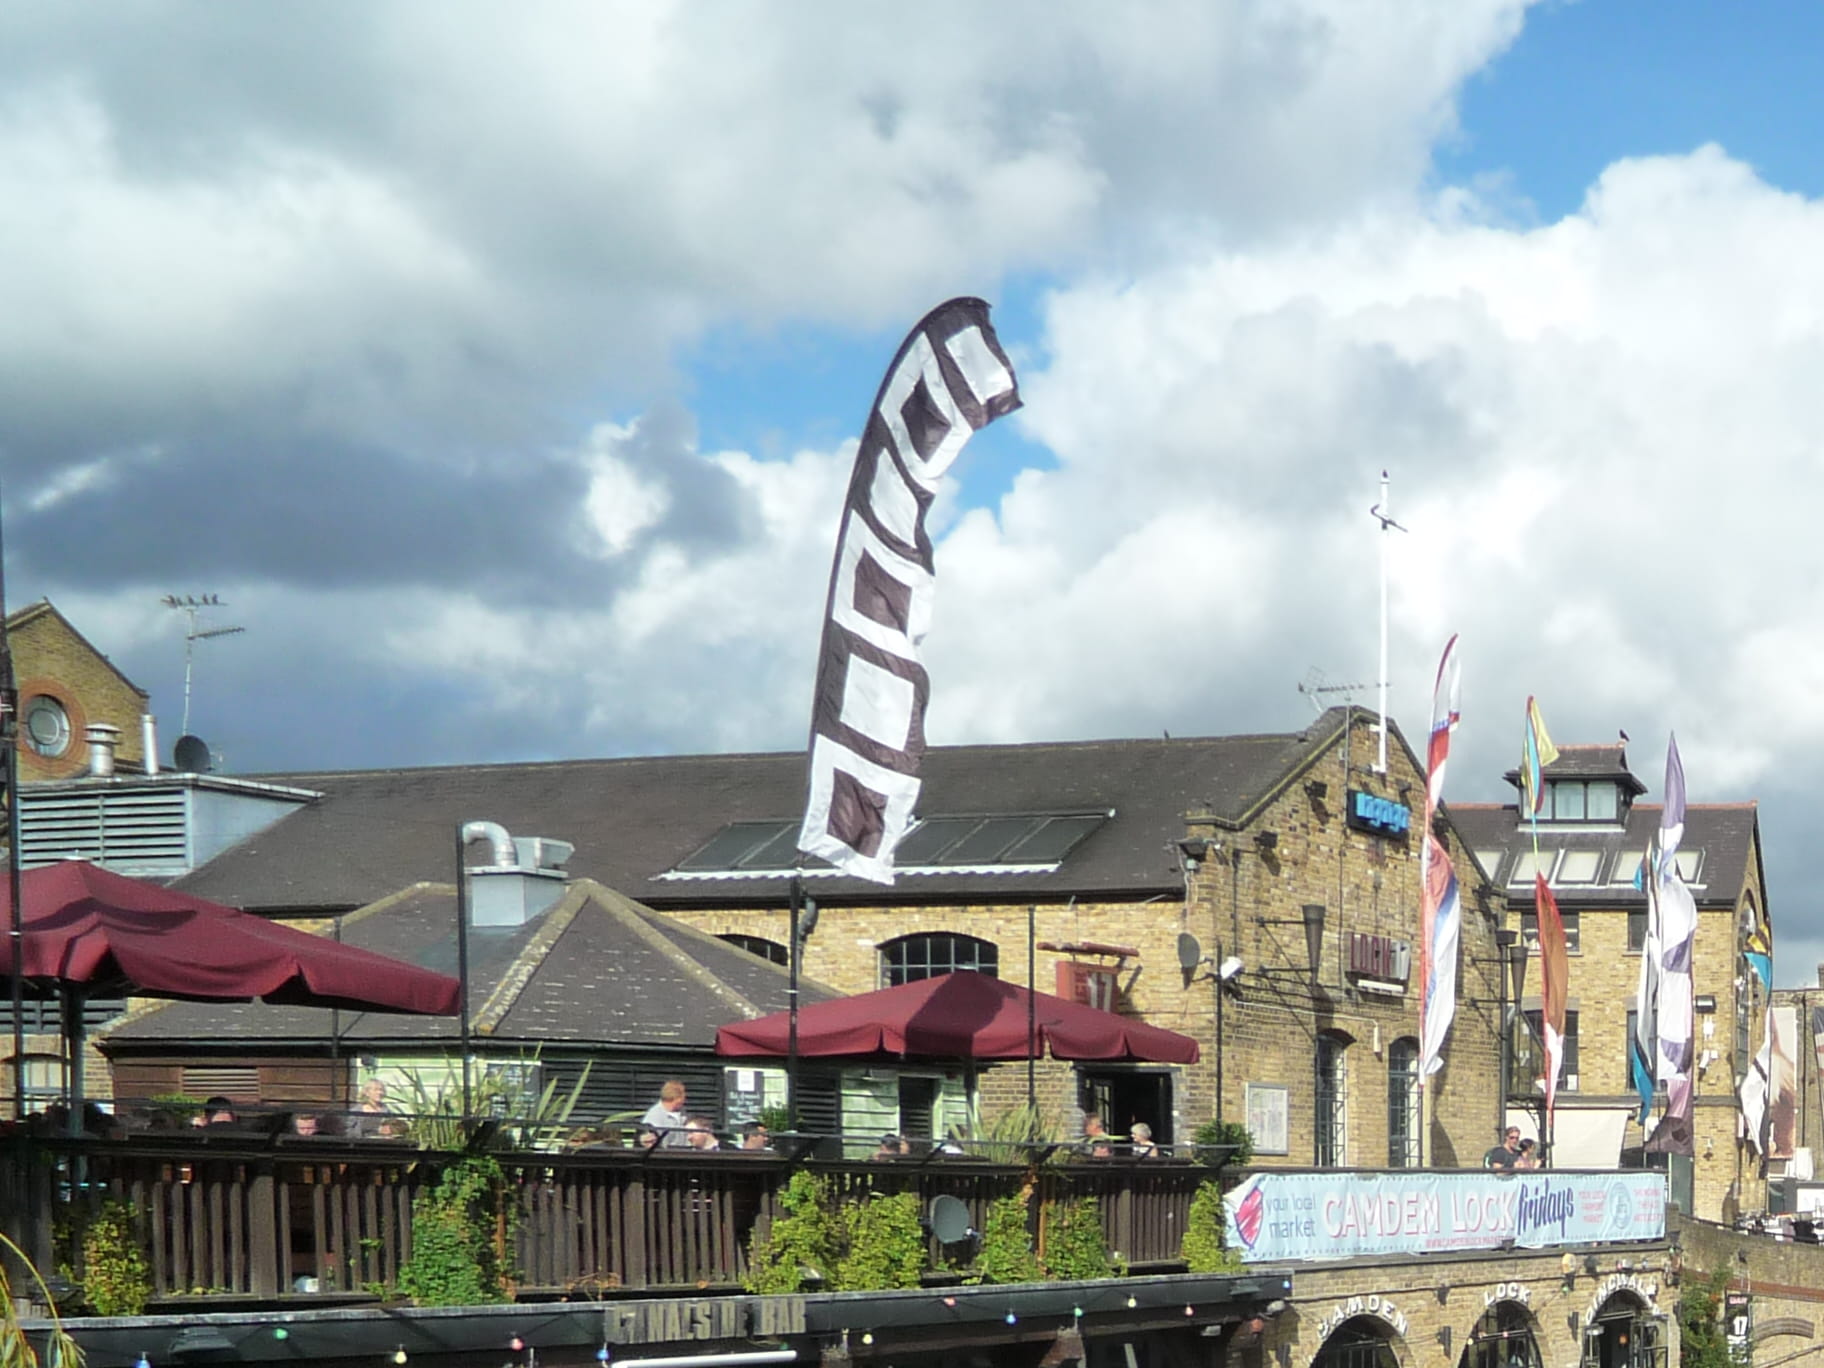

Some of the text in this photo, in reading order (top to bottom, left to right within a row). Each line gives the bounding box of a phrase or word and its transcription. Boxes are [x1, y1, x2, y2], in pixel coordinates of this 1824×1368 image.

[1266, 1191, 1316, 1216] your local
[1324, 1177, 1574, 1239] CAMDEN LOCK fridays
[1269, 1215, 1316, 1239] market
[1484, 1282, 1531, 1307] LOCK
[762, 1297, 806, 1335] BAR
[1317, 1294, 1408, 1339] CAMDEN
[1733, 1315, 1748, 1336] 17
